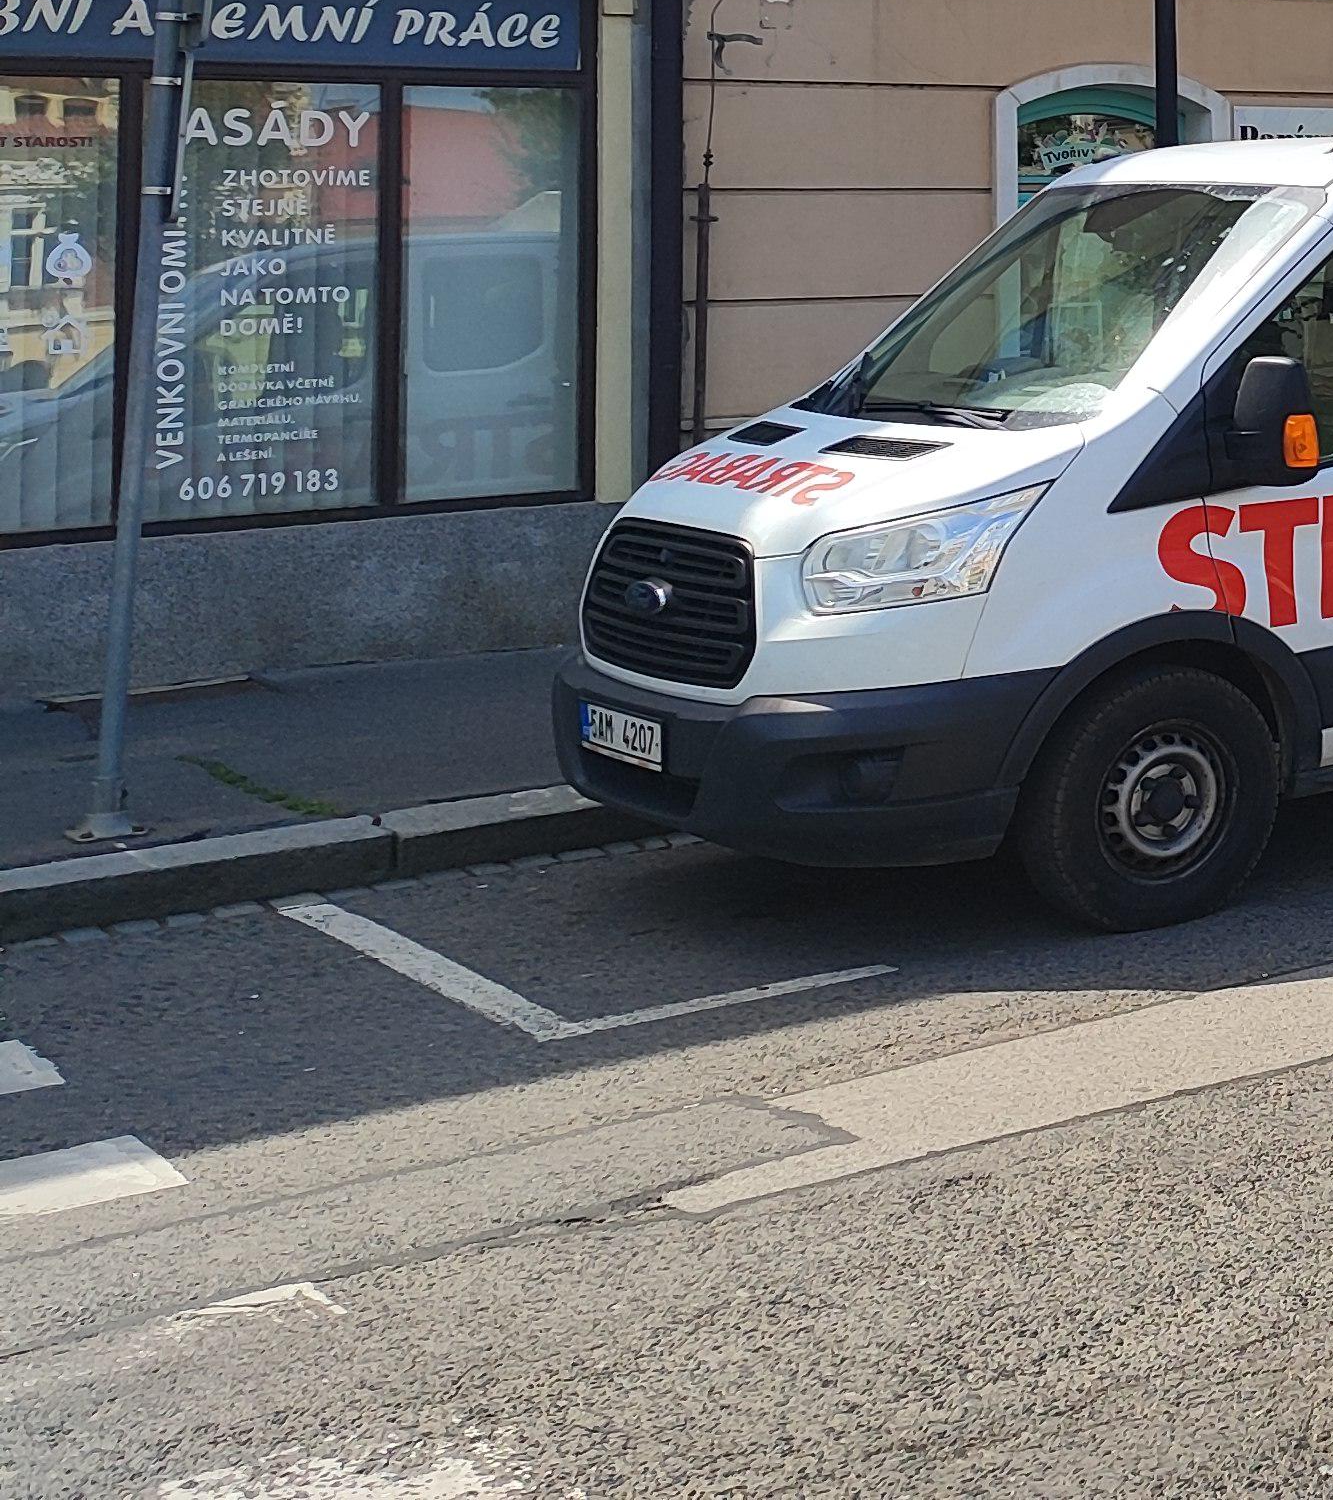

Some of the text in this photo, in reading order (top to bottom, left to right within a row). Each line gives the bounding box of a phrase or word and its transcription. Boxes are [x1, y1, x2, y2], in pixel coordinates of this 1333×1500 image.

[393, 1, 561, 49] PRÁCE
[186, 100, 371, 148] ASÁDY
[222, 166, 371, 187] ZHOTOVÍME
[221, 223, 336, 247] KVALITNĚ
[220, 257, 287, 277] JAKO
[220, 285, 351, 306] NA TOMTO
[220, 313, 303, 337] DOMĚ!
[218, 361, 295, 376] KOMPLETNÍ
[218, 375, 335, 393] DODÁVKA VČETNĚ
[218, 395, 303, 411] GRAFICKÉHO
[216, 452, 227, 462] A
[179, 468, 339, 501] 606 719 183
[622, 718, 655, 756] 4207
